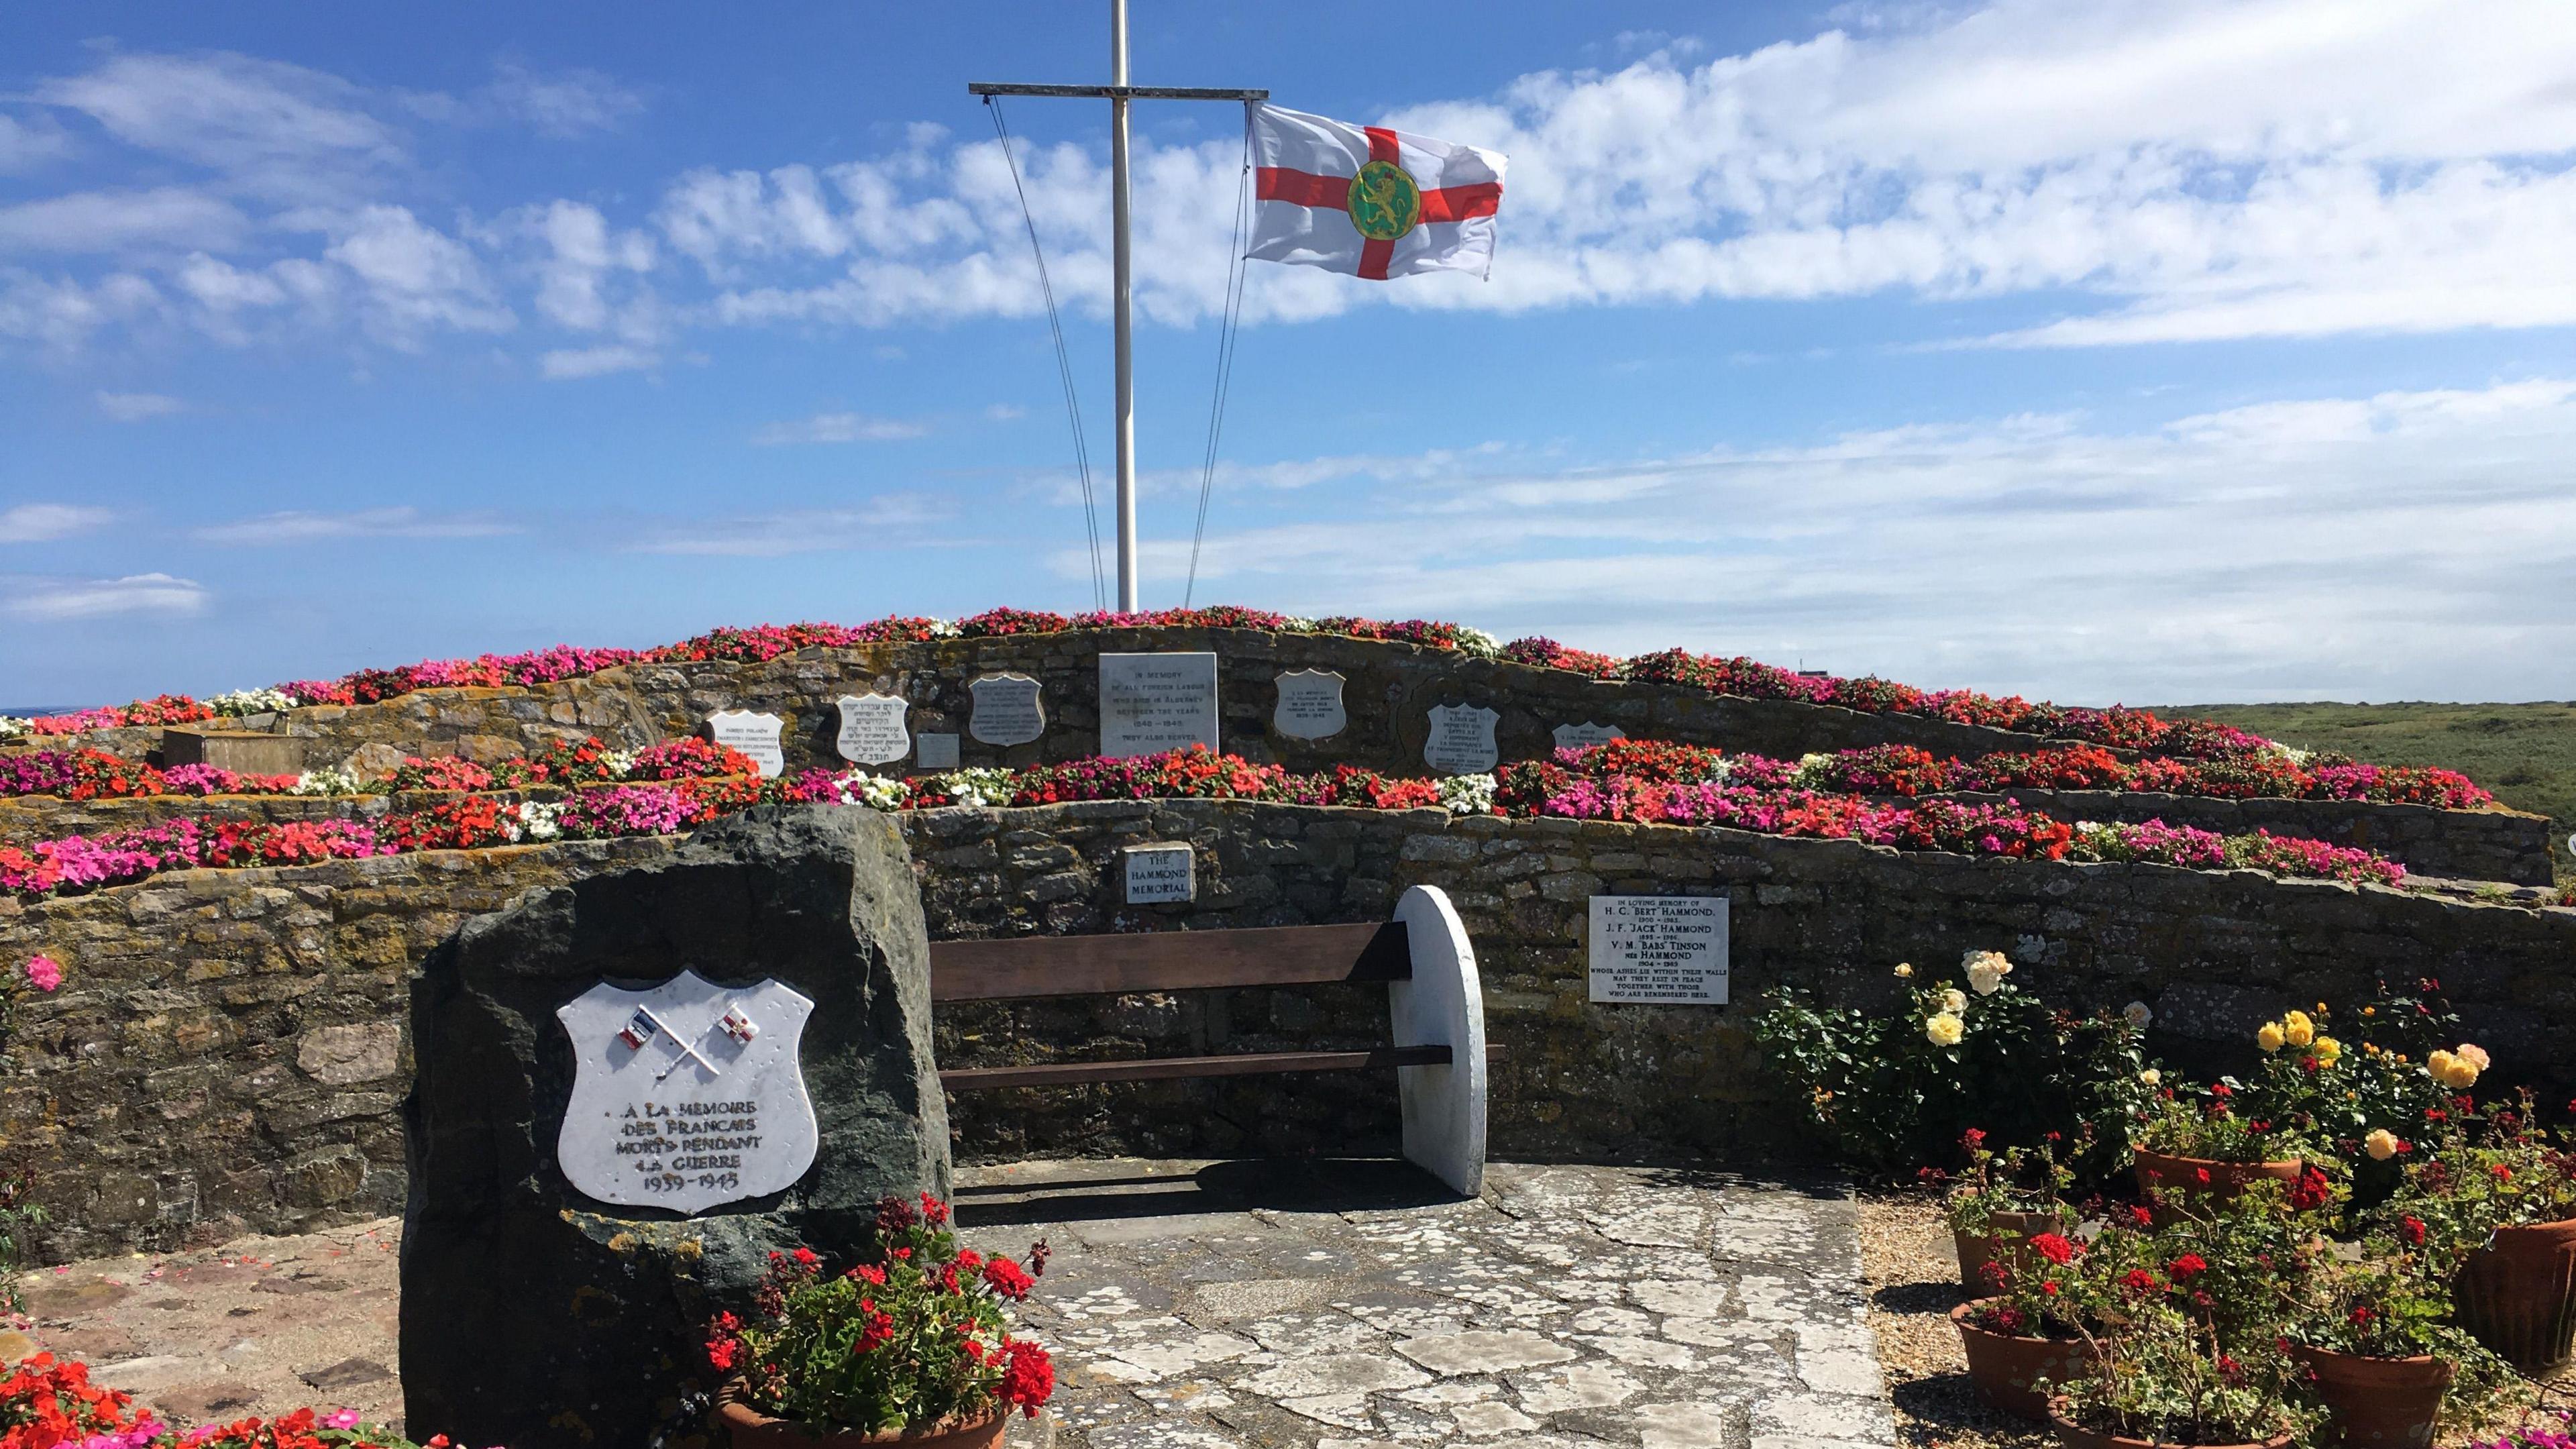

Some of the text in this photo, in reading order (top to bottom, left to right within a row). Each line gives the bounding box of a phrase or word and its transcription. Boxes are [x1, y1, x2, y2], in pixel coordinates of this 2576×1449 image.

[1149, 856, 1169, 865] THE
[1131, 869, 1187, 880] HAMMOND
[1132, 883, 1186, 894] MEMORIAL
[1619, 908, 1629, 916] C.
[1662, 907, 1716, 917] HAMMOND.
[1605, 924, 1615, 933] J.
[1661, 924, 1712, 934] HAMMOND
[1670, 941, 1707, 951] TINSON
[1640, 951, 1692, 960] HAMMOND
[645, 1102, 669, 1118] LA
[624, 1120, 657, 1136] DES
[616, 1134, 762, 1155] MORTS PENDANT
[639, 1155, 741, 1172] LA GUERRE
[644, 1171, 739, 1193] 1939-1945
